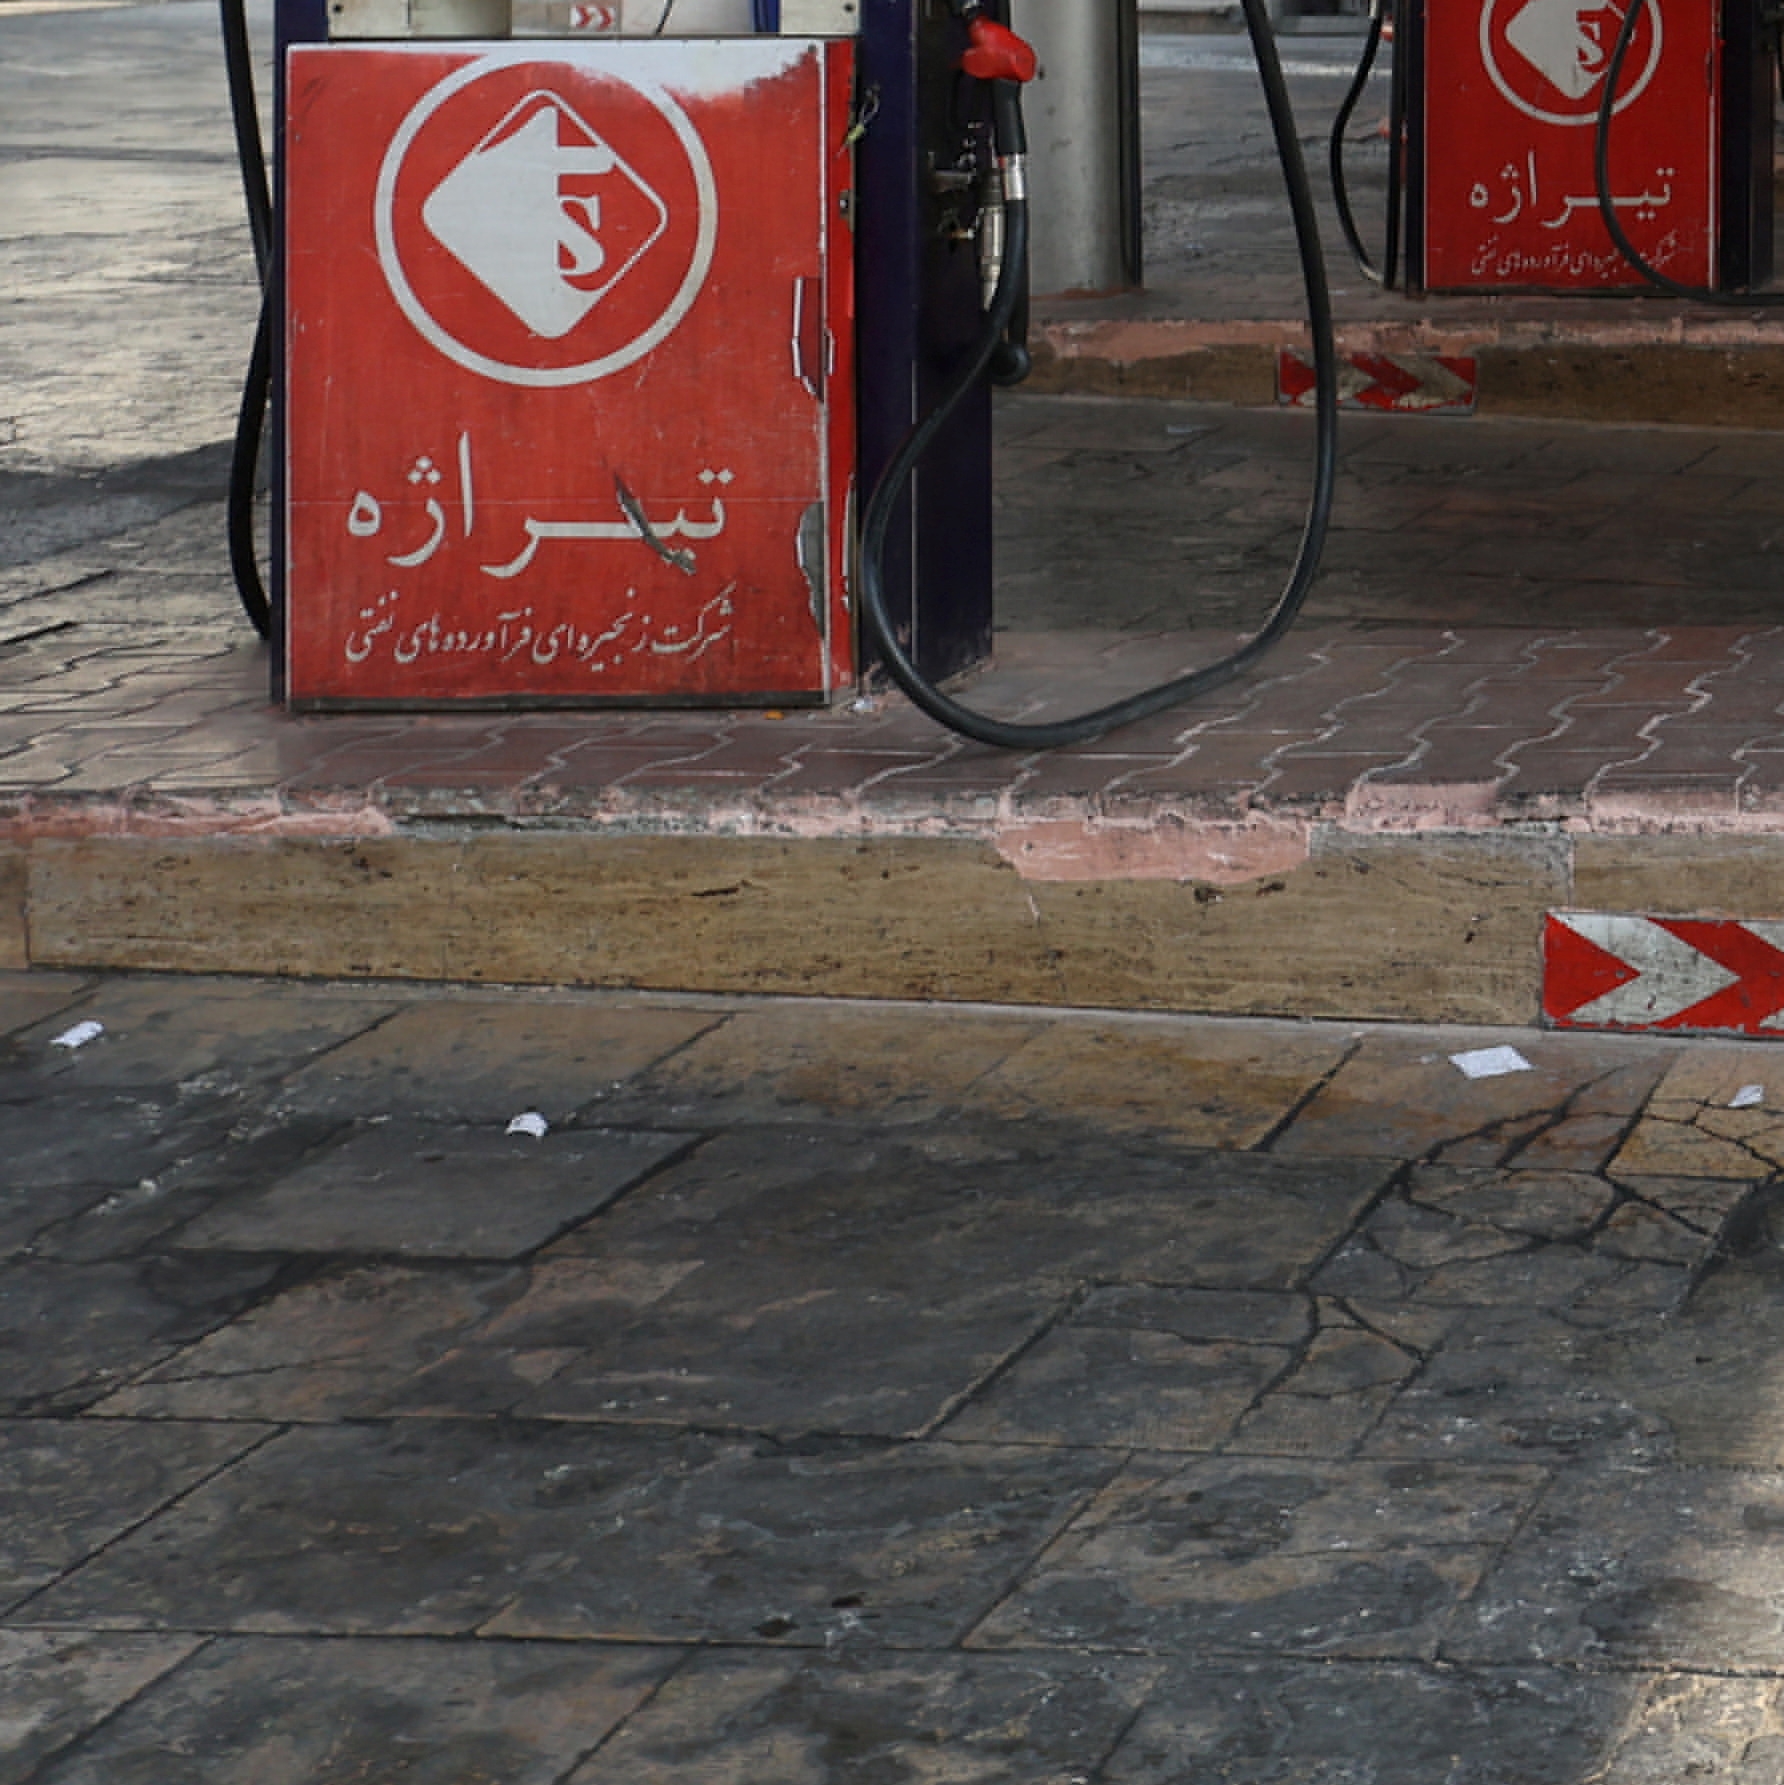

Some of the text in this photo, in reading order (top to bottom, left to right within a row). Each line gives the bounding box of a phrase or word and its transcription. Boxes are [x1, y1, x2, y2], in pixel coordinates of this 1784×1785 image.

[1469, 148, 1676, 228] تیراژه
[347, 430, 735, 578] تیراژه
[345, 589, 399, 663] نفتی
[650, 582, 737, 663] شرکت
